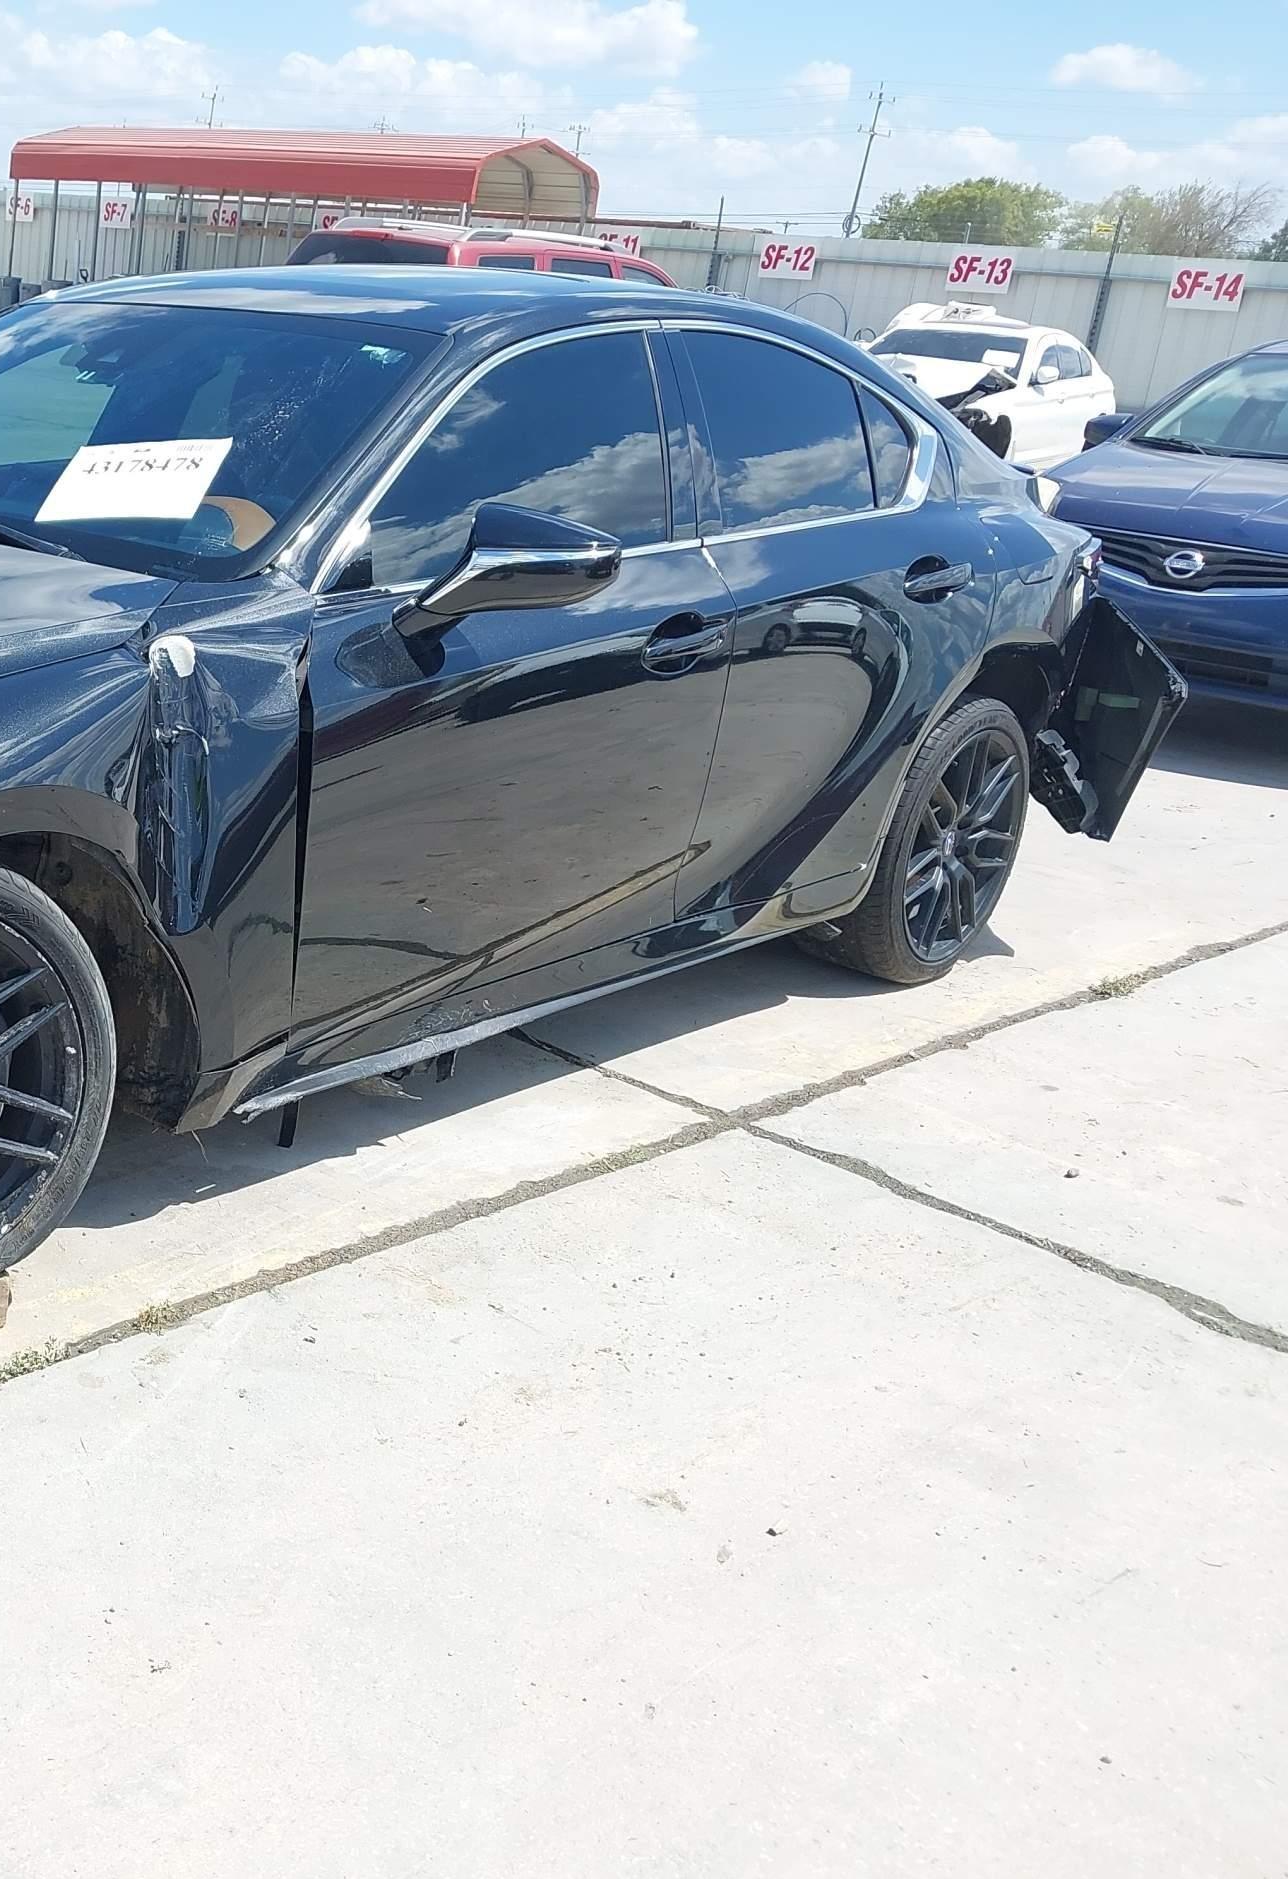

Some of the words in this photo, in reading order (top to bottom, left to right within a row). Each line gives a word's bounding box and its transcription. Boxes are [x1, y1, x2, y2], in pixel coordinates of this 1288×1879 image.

[8, 196, 31, 216] SF-6
[103, 201, 128, 222] SF-7
[760, 244, 815, 272] SF-12
[948, 255, 1013, 285] SF-13
[1171, 269, 1244, 302] SF-14
[82, 457, 204, 476] 43178478
